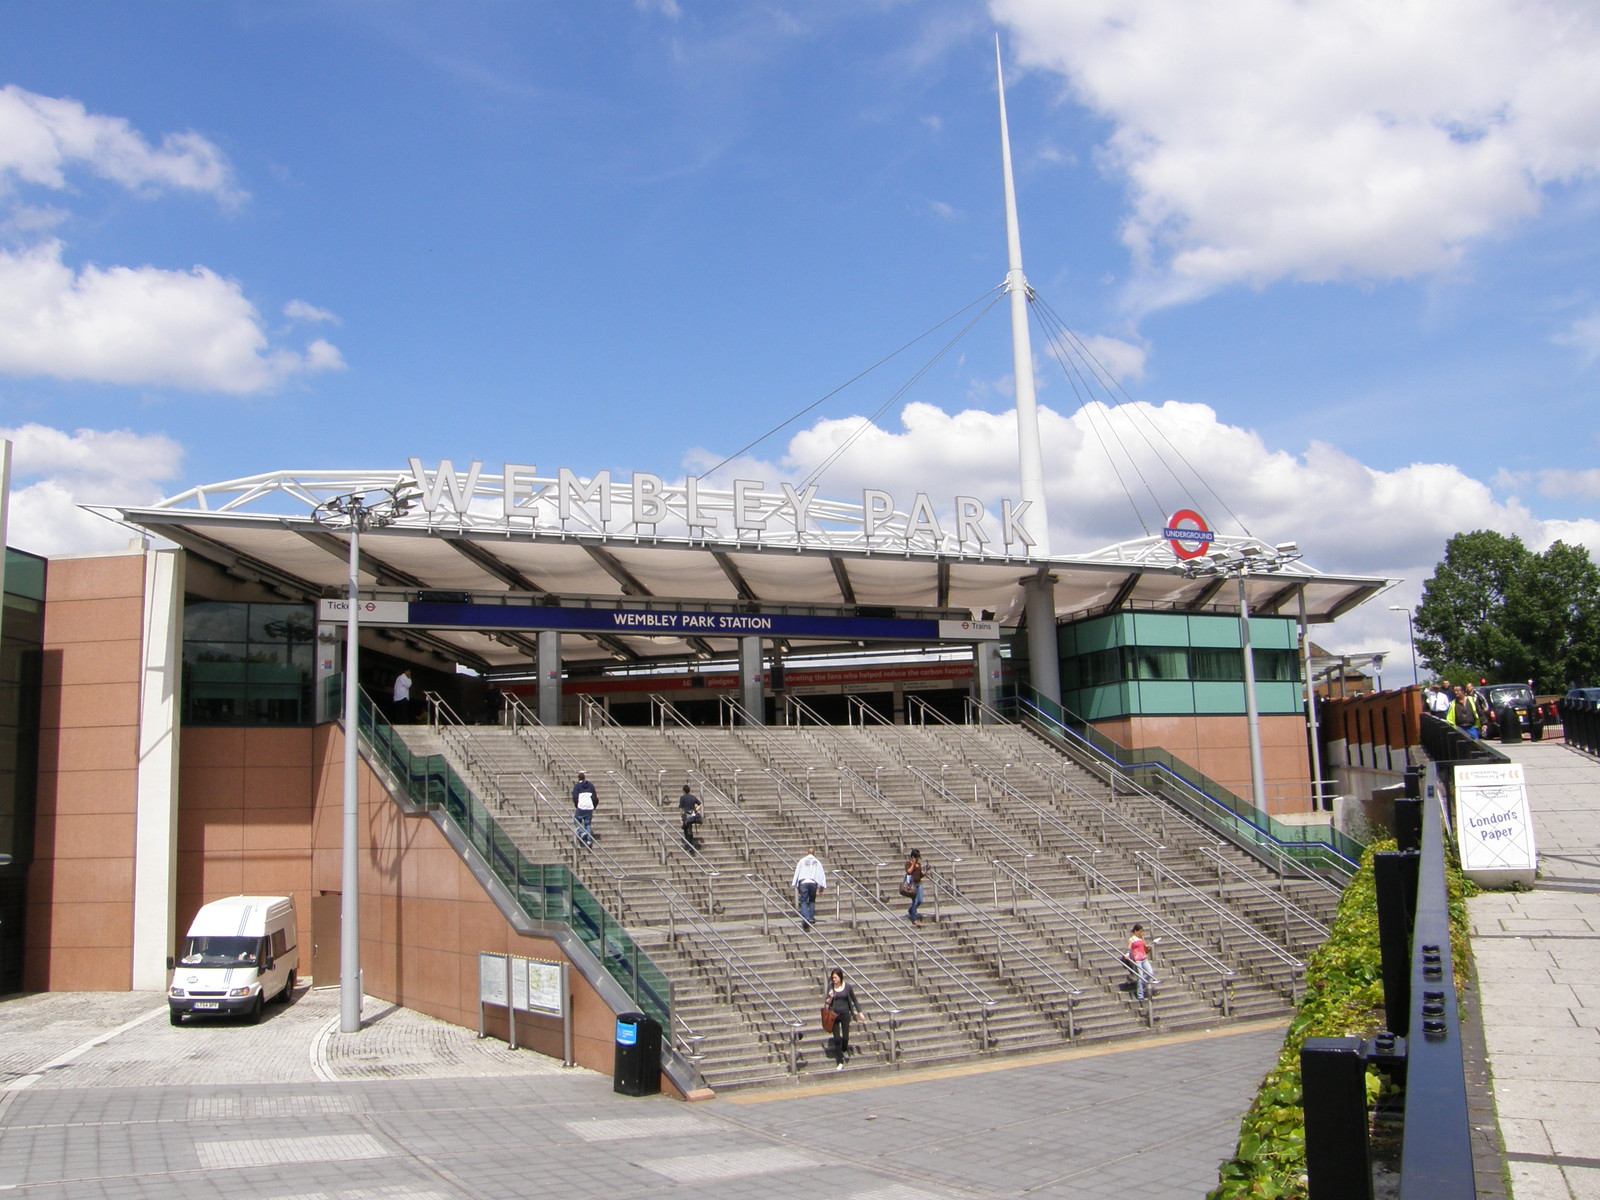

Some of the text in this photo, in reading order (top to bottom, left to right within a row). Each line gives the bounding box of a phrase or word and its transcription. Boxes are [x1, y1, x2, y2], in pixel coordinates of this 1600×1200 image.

[408, 456, 1037, 547] WEMBLEY PARK
[1165, 530, 1213, 540] UNDERGROUND
[328, 601, 362, 610] Tickes
[613, 613, 772, 629] WEMBLEY PARK STATION
[859, 670, 883, 680] helped
[884, 670, 906, 678] reduce
[908, 668, 920, 676] the
[920, 668, 944, 676] carbon
[1469, 810, 1518, 828] London's
[1480, 827, 1513, 841] Paper
